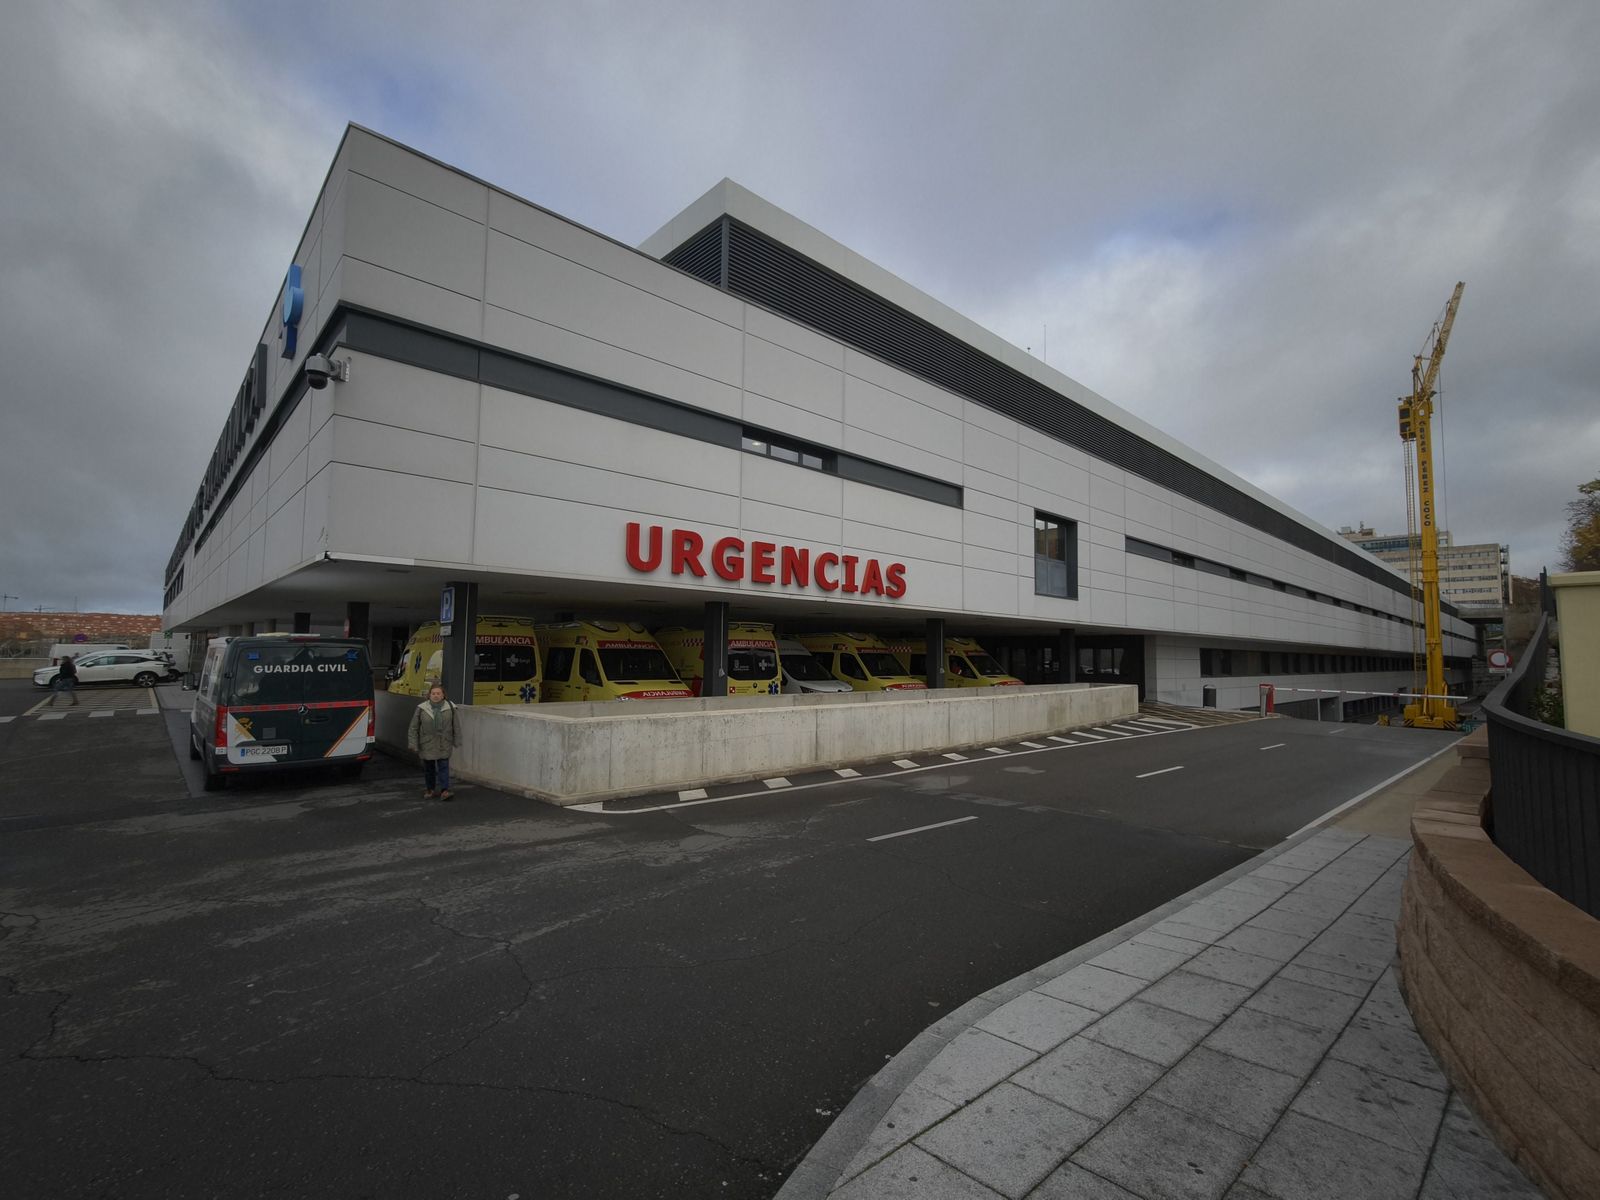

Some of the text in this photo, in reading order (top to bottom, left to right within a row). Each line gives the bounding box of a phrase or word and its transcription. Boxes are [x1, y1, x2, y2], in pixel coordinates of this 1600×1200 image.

[625, 522, 907, 599] URGENCIAS
[443, 591, 451, 619] P
[475, 636, 531, 645] MBULANCIA
[730, 640, 774, 648] AMBULANCIA
[254, 664, 348, 673] GUARDIA CIVIL
[245, 748, 260, 756] PGC
